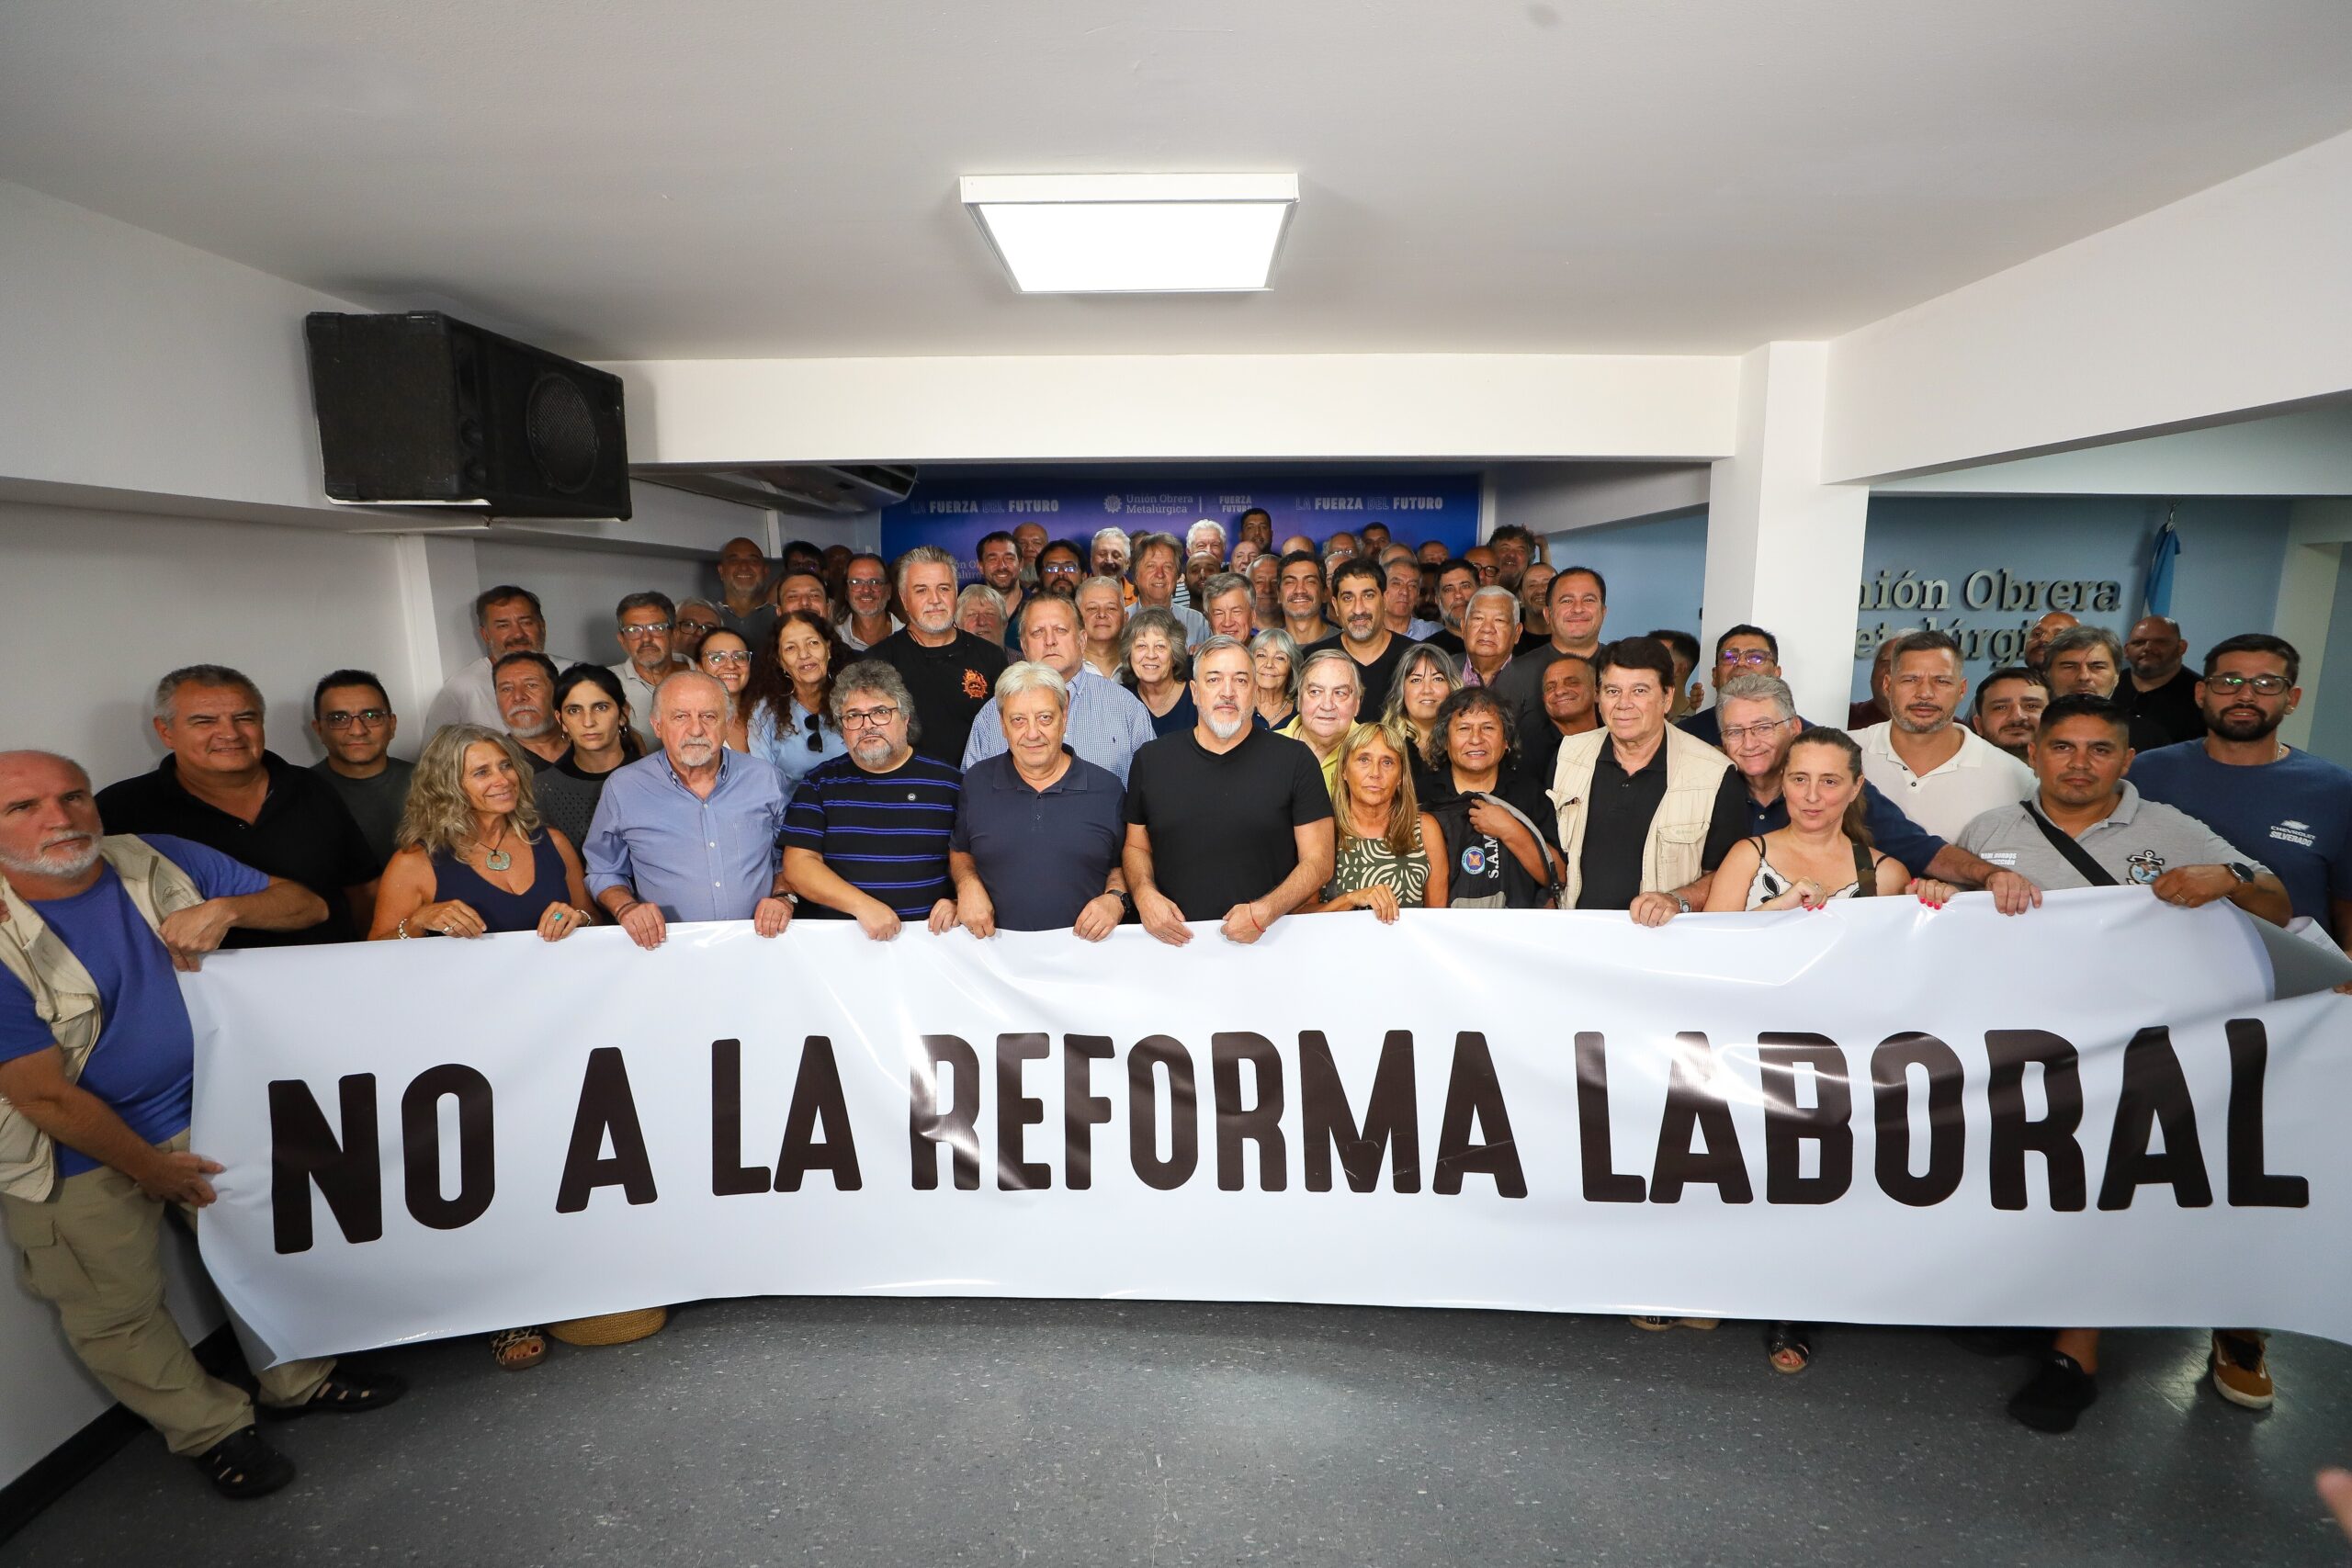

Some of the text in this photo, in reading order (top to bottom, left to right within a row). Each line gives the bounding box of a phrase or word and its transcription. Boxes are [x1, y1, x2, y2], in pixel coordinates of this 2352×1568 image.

[1125, 493, 1193, 503] Unión Obrera
[1219, 495, 1252, 504] FUERZA
[1315, 497, 1363, 510] FUERZA
[1393, 496, 1443, 510] FUTURO
[930, 500, 978, 513] FUERZA
[1008, 500, 1059, 513] FUTURO
[1125, 503, 1188, 515] Metalúrgica
[1964, 568, 2121, 611] Obrera
[2269, 830, 2313, 847] SILVERADO
[2270, 825, 2316, 840] CHEVROLET
[267, 1018, 2310, 1255] NO A LA REFORMA LABORAL
